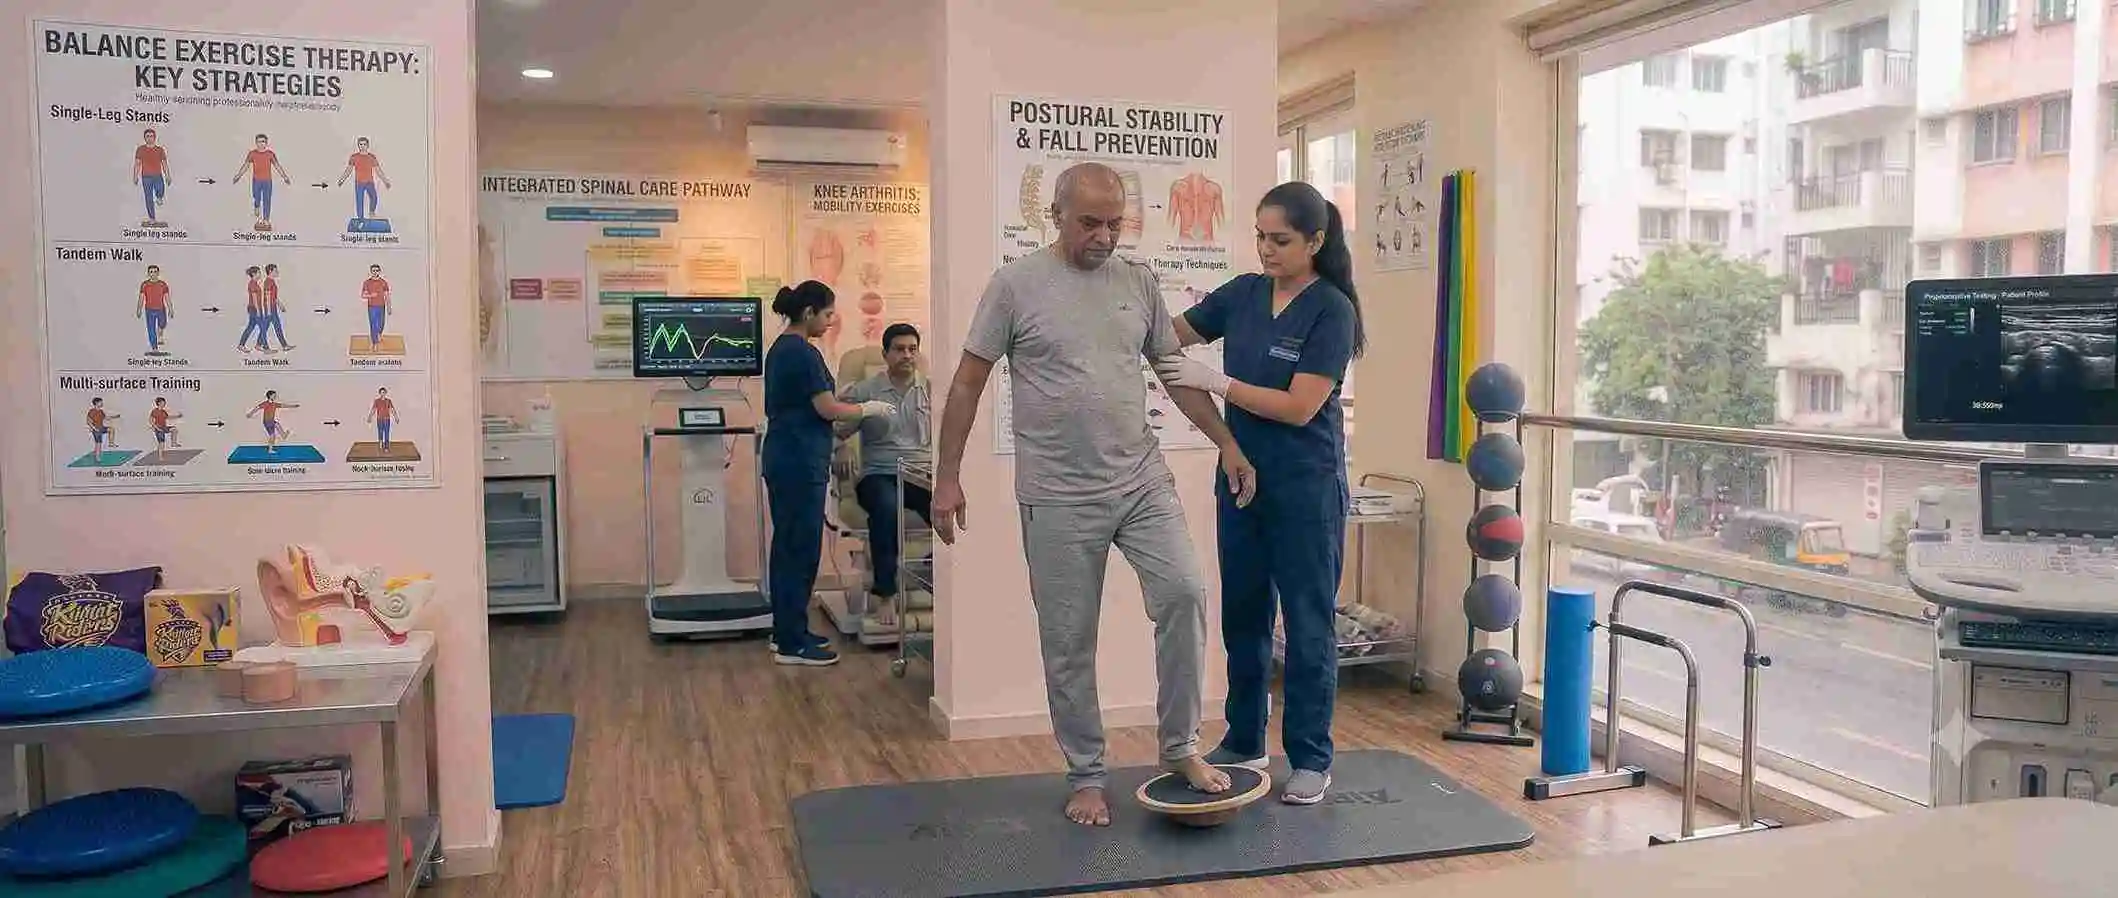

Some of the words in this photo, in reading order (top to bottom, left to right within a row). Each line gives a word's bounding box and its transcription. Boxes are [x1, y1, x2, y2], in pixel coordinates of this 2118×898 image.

[44, 29, 167, 60] BALANCE
[175, 39, 296, 68] EXERCISE
[303, 47, 419, 75] THERAPY:
[135, 65, 184, 89] KEY
[192, 68, 342, 97] STRATEGIES
[50, 104, 121, 122] Single-Leg
[125, 108, 169, 123] Stands
[1009, 101, 1120, 128] POSTURAL
[1126, 108, 1224, 135] STABILITY
[1016, 128, 1031, 149] &
[1039, 129, 1088, 151] FALL
[1094, 132, 1218, 159] PREVENTION
[482, 176, 576, 194] INTEGRATED
[580, 179, 635, 195] SPINAL
[639, 181, 678, 197] CARE
[682, 183, 752, 198] PATHWAY
[813, 184, 847, 199] KNEE
[850, 185, 921, 201] ARTHRITIS:
[813, 200, 862, 213] MOBILITY
[865, 202, 921, 215] EXERCISES
[56, 247, 106, 260] Tandem
[111, 248, 143, 261] Walk
[1154, 258, 1183, 270] Therapy
[1185, 258, 1228, 271] Techniques
[60, 377, 146, 389] Multi-surface
[150, 377, 200, 391] Training
